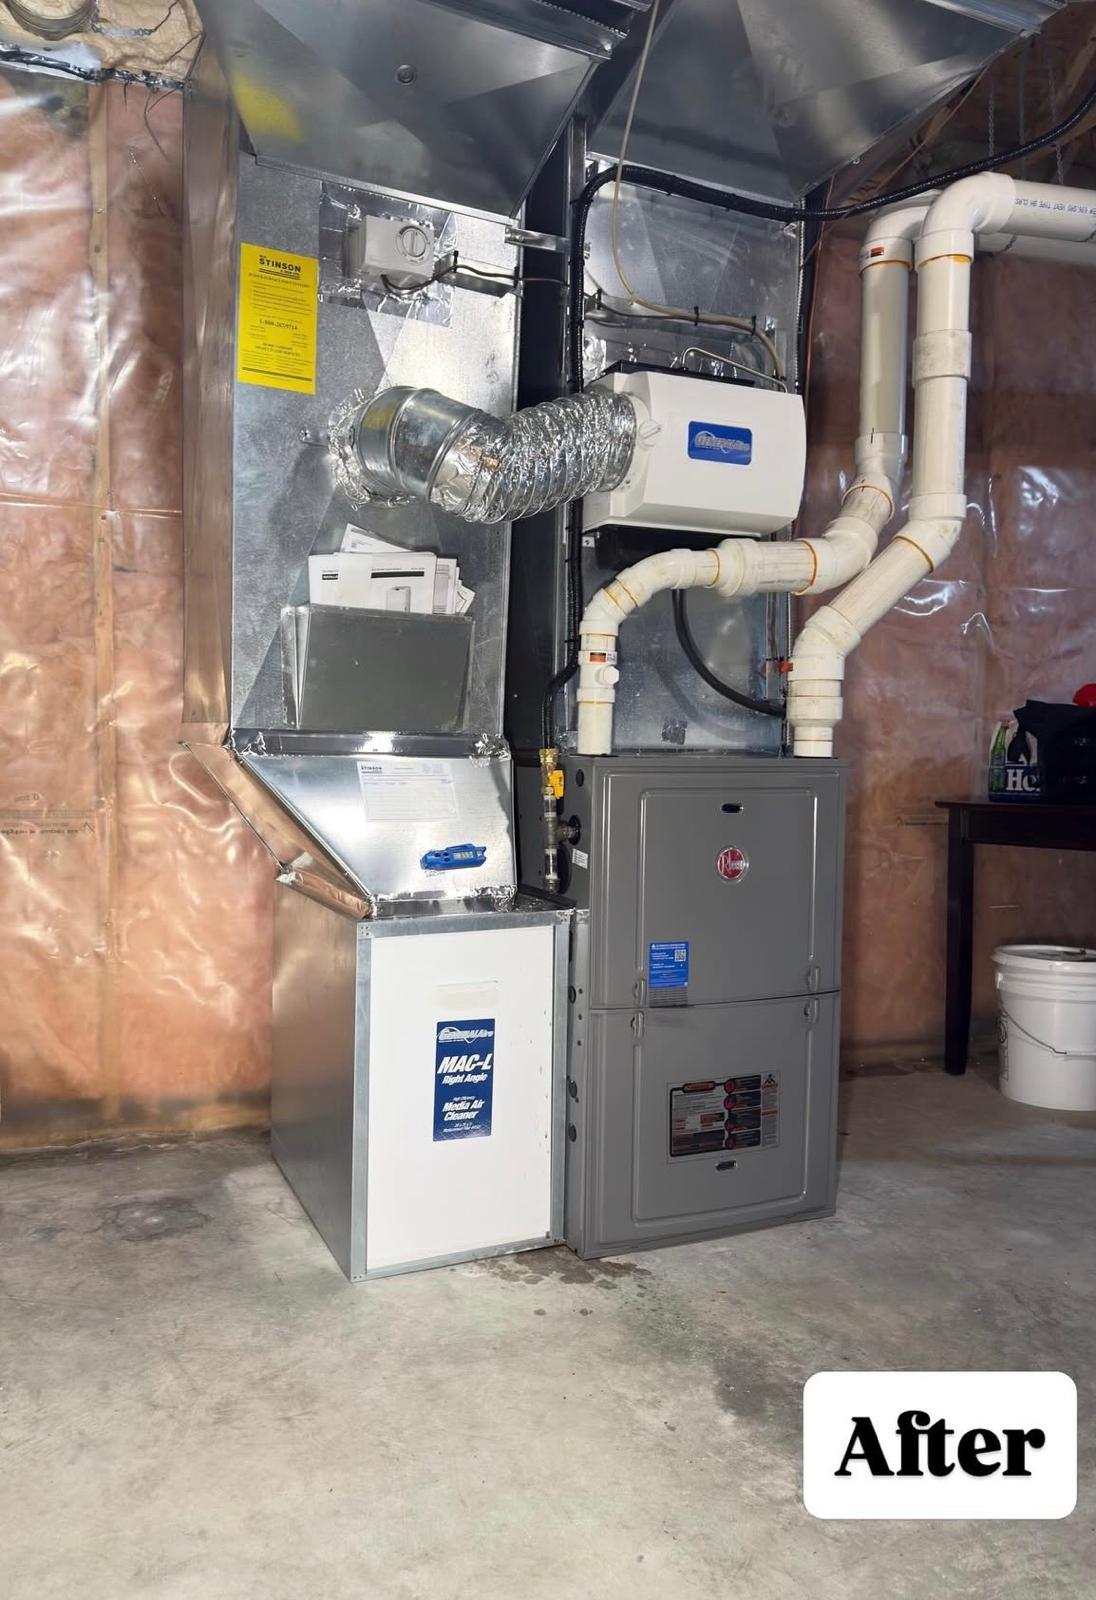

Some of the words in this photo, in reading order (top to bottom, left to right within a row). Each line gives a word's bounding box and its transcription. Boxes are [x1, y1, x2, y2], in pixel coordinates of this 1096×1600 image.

[259, 257, 301, 273] STINSON
[437, 1053, 493, 1074] MAC-L
[442, 1074, 465, 1085] Right
[464, 1072, 488, 1083] Angle
[442, 1101, 470, 1112] Media
[470, 1099, 485, 1109] Air
[444, 1110, 479, 1121] Cleaner
